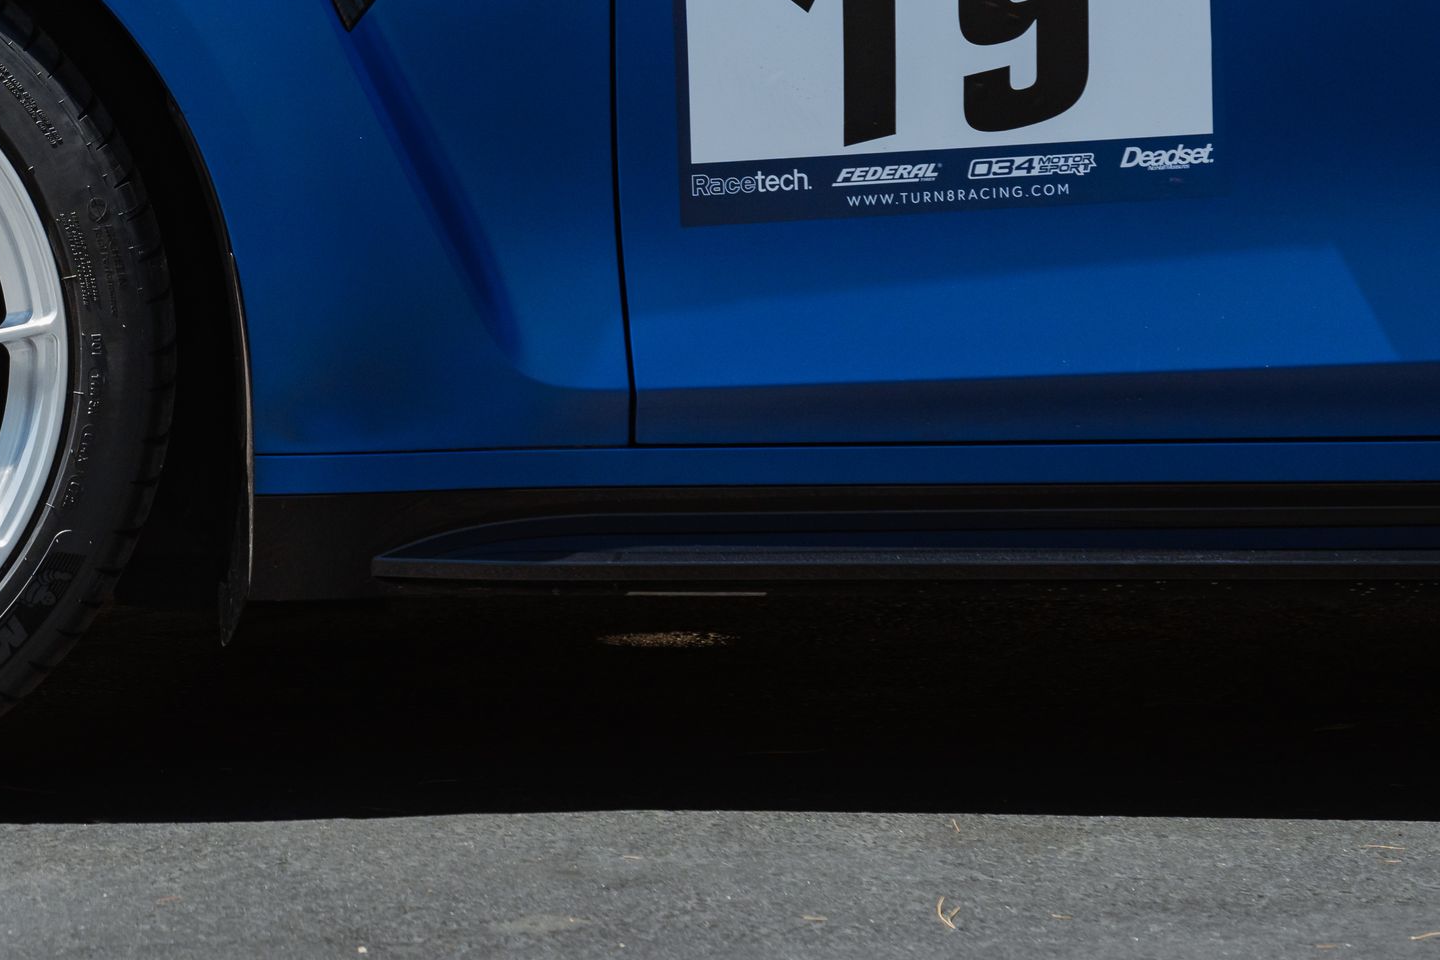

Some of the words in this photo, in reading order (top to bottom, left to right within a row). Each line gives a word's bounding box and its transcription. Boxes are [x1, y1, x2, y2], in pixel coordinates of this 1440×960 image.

[1037, 153, 1094, 165] MOTOR
[1120, 143, 1214, 168] Deadset.
[836, 163, 939, 182] FEDERAL
[1037, 162, 1091, 175] SPORT
[691, 168, 813, 197] Racetech.
[846, 183, 1070, 208] WWW.TURN8RACING.COM
